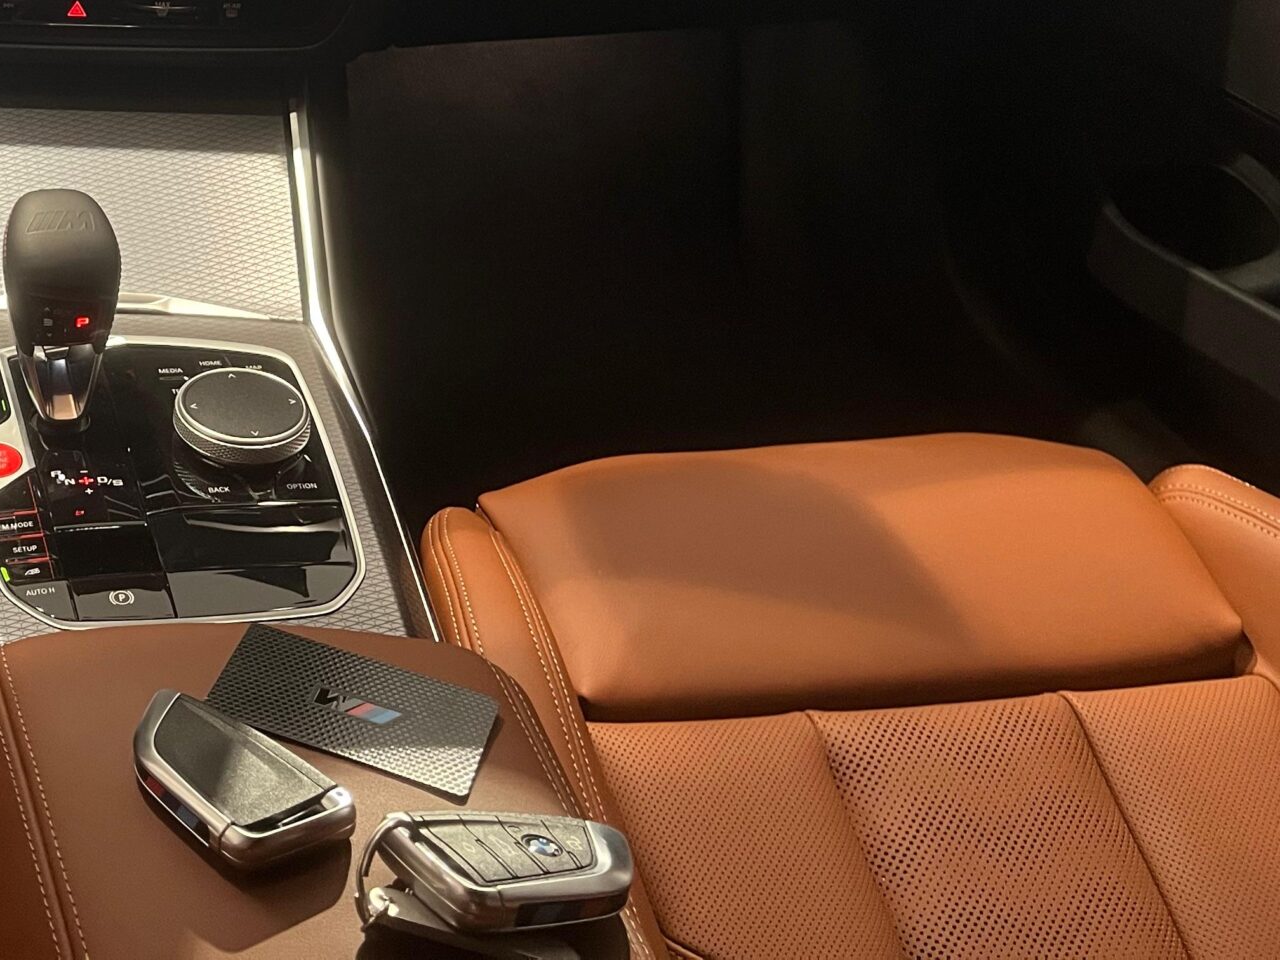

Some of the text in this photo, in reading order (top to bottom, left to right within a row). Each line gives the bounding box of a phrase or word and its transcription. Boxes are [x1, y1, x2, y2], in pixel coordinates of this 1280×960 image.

[76, 317, 90, 328] P
[65, 478, 76, 486] N
[286, 482, 318, 490] OPTION
[207, 486, 231, 494] BACK
[12, 545, 38, 554] SETUP
[26, 588, 48, 597] AUTO
